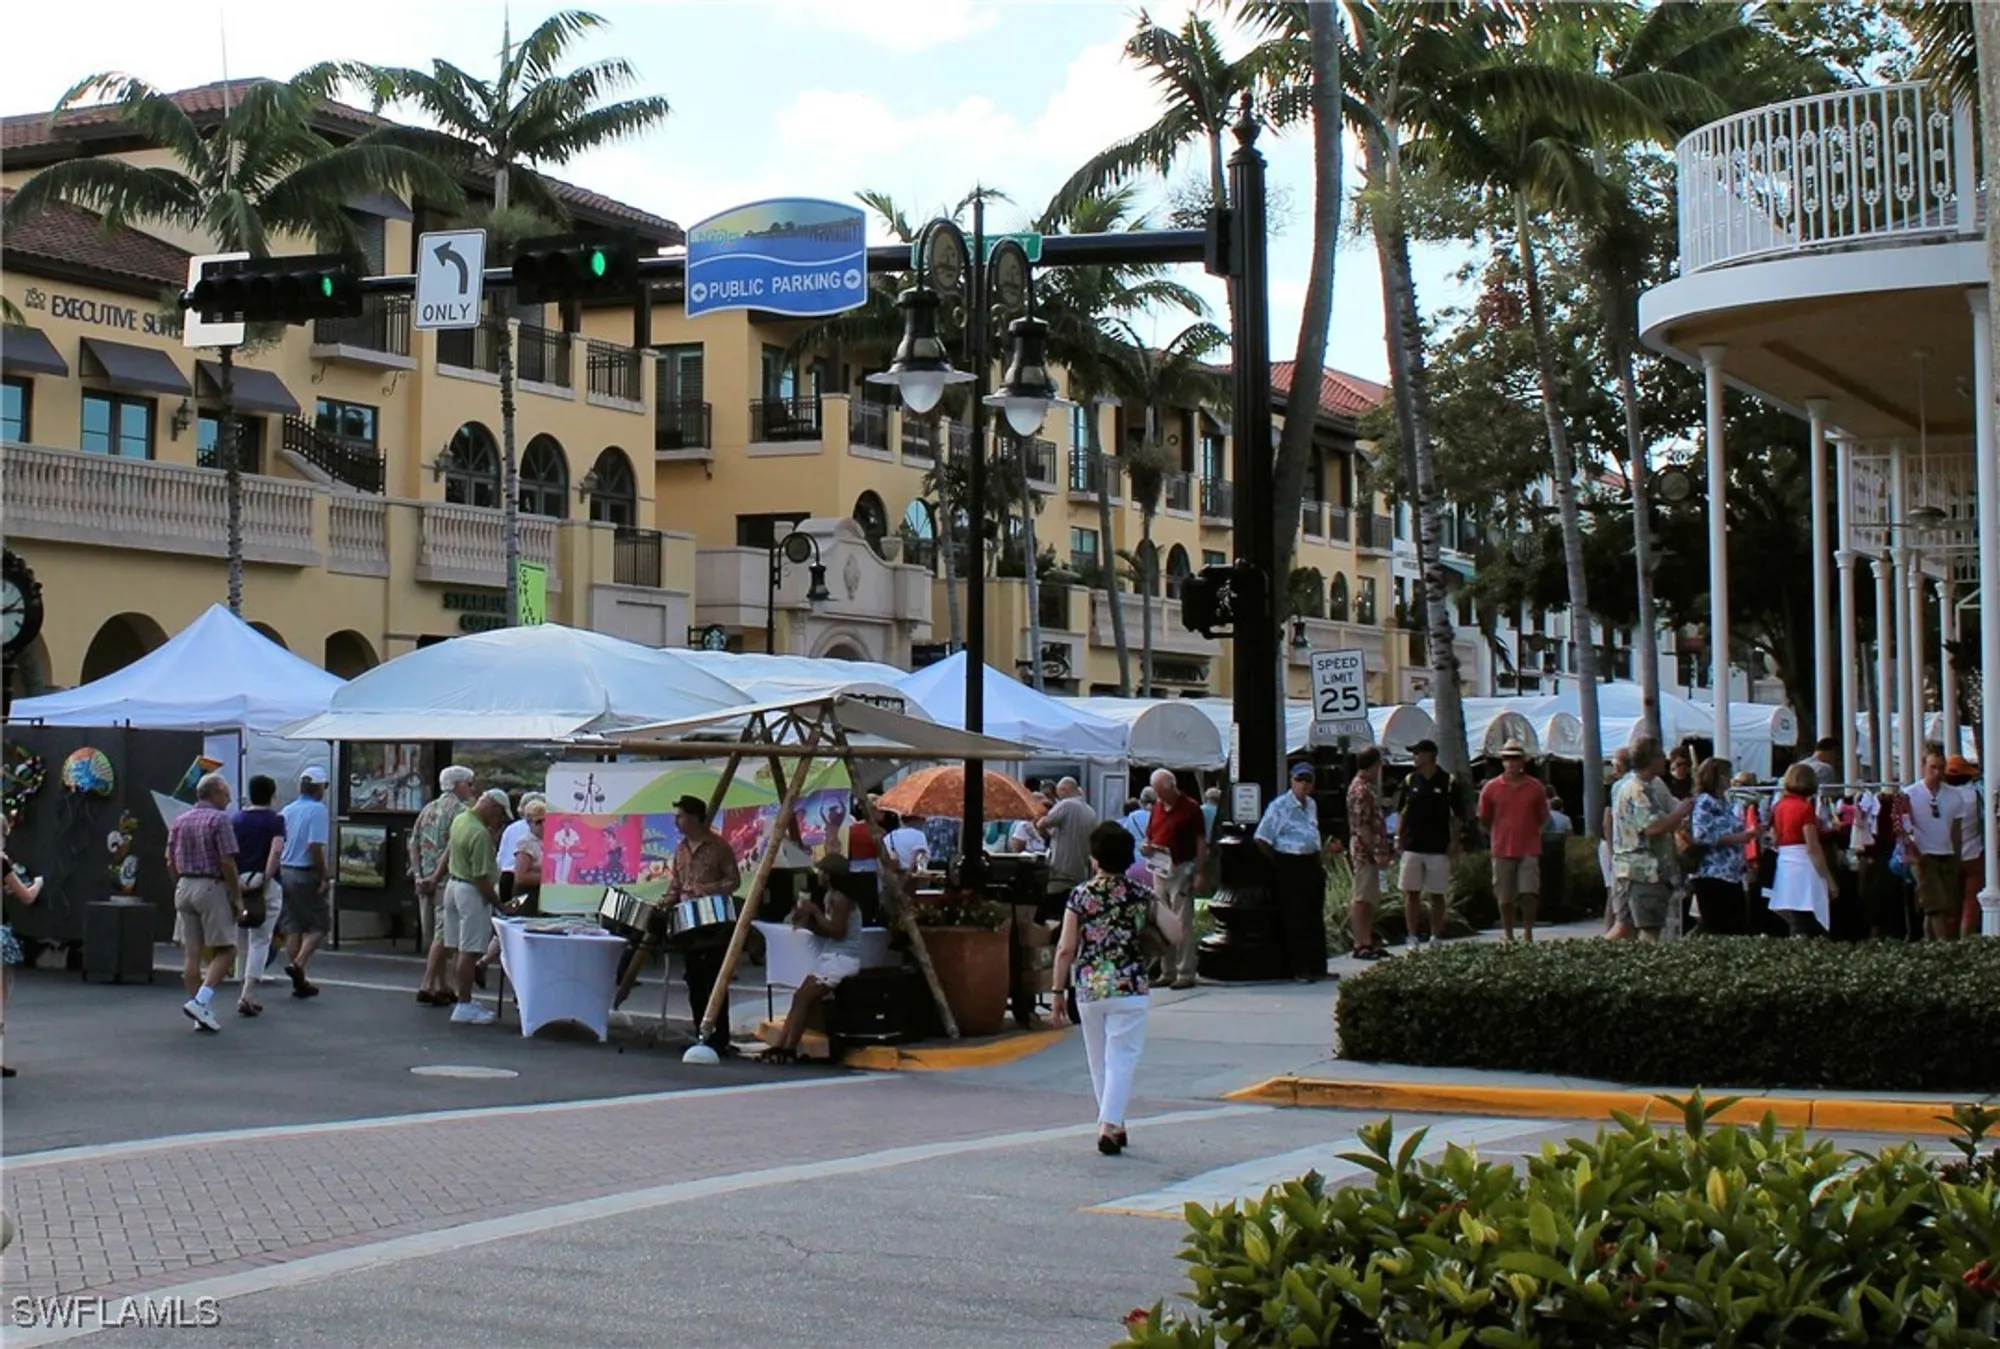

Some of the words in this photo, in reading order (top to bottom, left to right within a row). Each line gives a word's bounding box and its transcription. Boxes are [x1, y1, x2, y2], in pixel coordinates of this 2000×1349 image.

[709, 278, 764, 299] PUBLIC
[772, 271, 841, 294] PARKING
[52, 294, 137, 331] EXECUTIVE
[423, 303, 471, 321] ONLY
[1317, 656, 1359, 671] SPEED
[1322, 671, 1354, 685] LIMIT
[1320, 686, 1361, 713] 25
